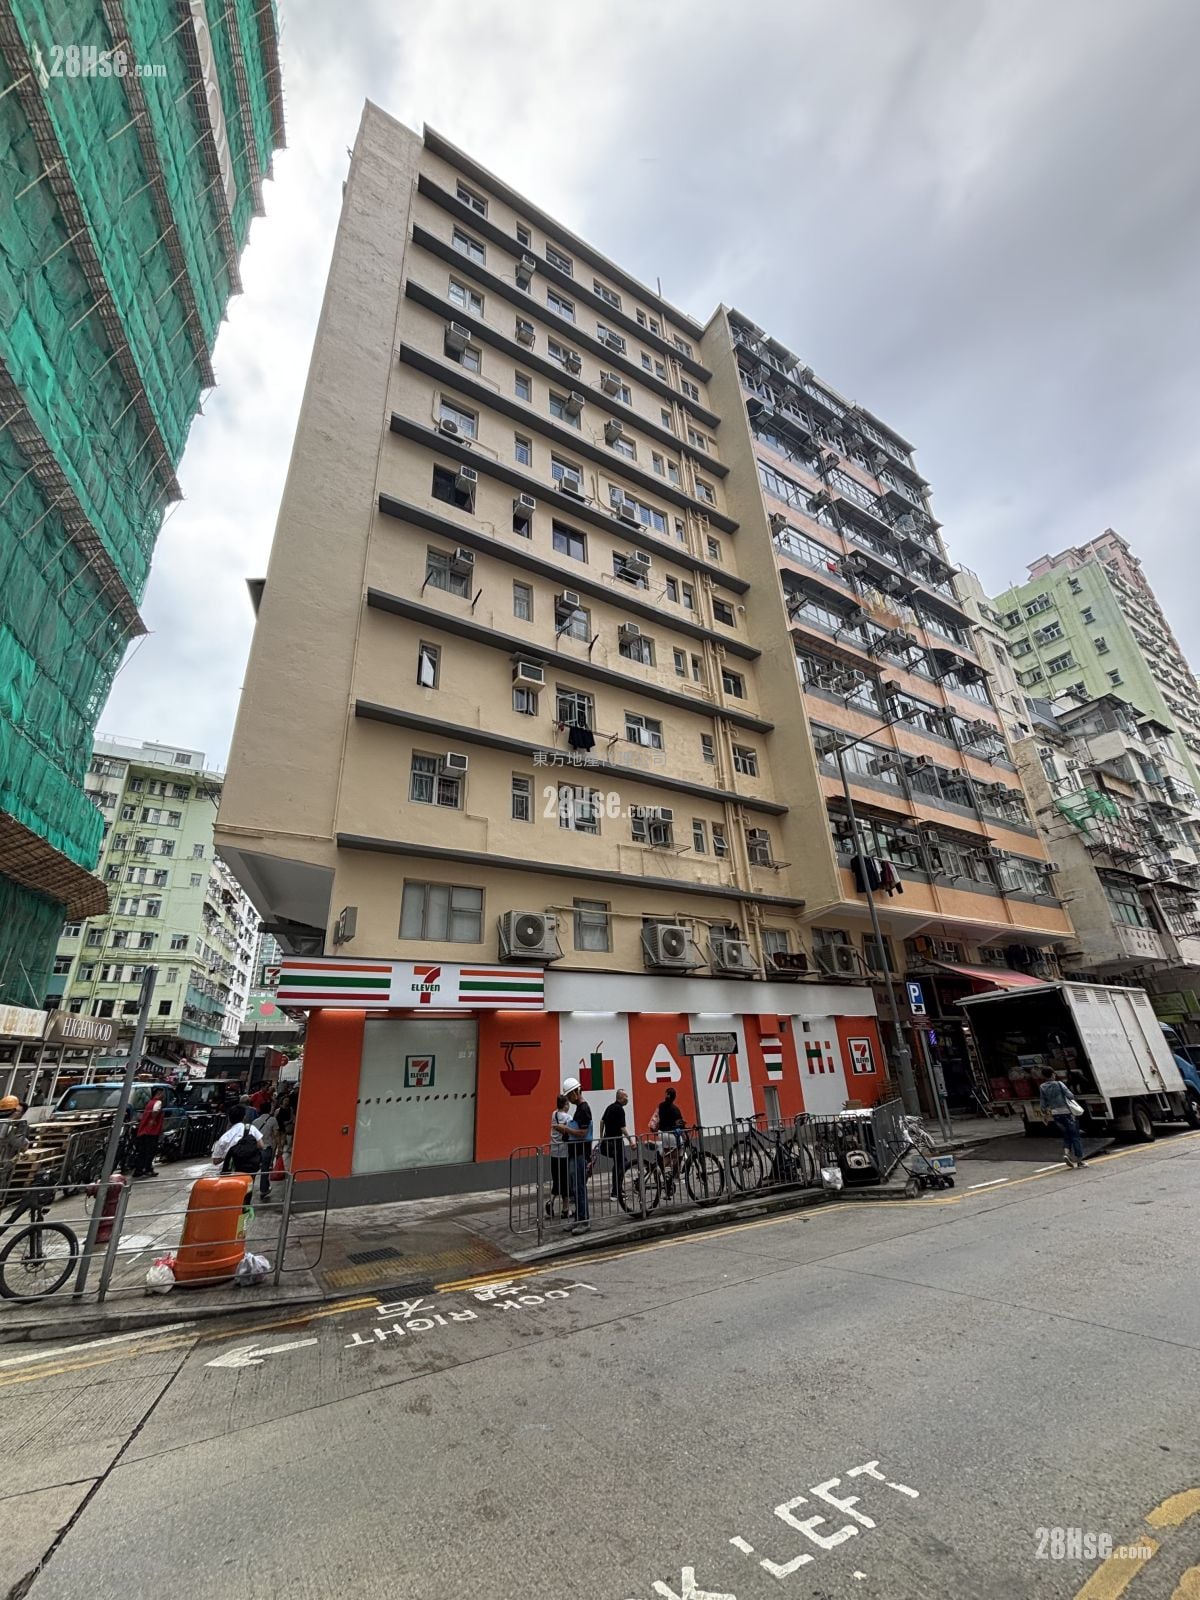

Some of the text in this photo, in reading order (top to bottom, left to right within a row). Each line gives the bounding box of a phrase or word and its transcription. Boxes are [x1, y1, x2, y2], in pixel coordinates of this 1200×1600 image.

[909, 984, 920, 1003] P
[61, 1017, 113, 1042] HIGHWOOD
[344, 1282, 598, 1349] LOOK RIGHT
[729, 1460, 920, 1579] LEFT
